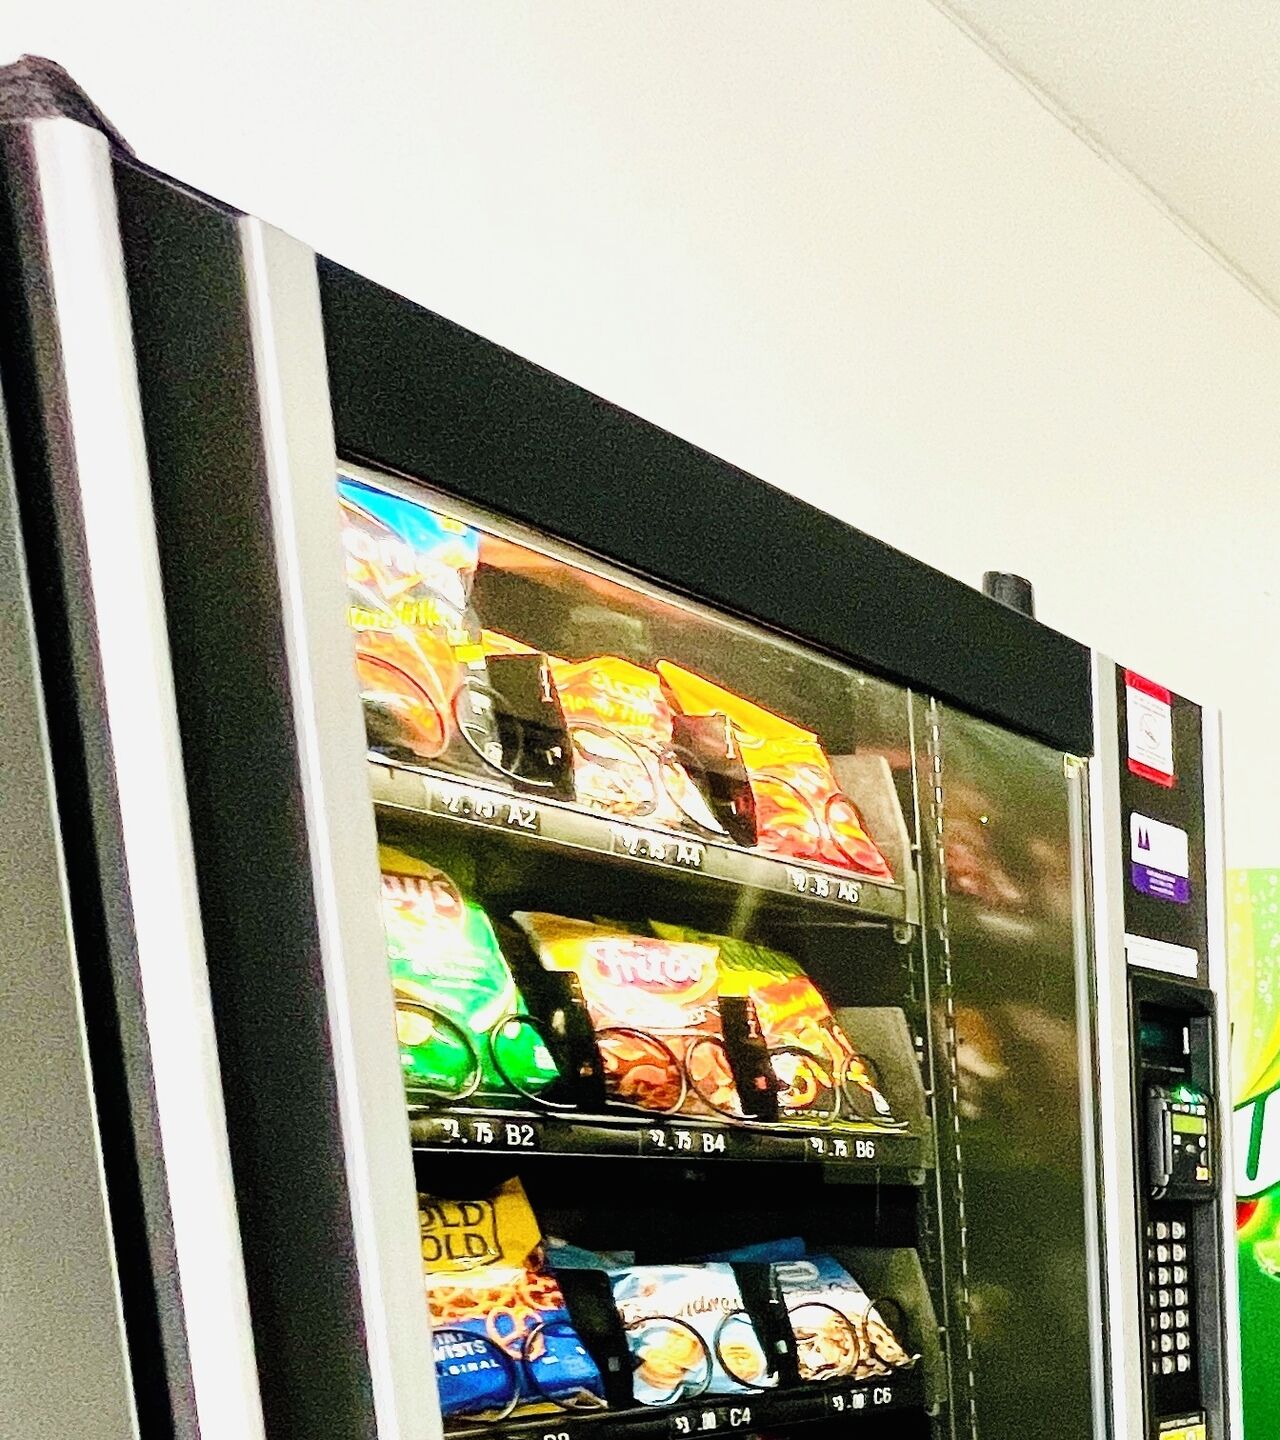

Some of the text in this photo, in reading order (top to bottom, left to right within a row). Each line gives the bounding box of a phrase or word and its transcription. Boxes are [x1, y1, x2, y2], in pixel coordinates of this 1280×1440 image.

[505, 804, 538, 830] A2
[676, 841, 702, 867] A4
[837, 882, 862, 904] A6
[505, 1123, 535, 1147] B2
[702, 1132, 726, 1154] B4
[855, 1139, 876, 1159] B6
[419, 1201, 486, 1229] OLD
[420, 1232, 489, 1263] OLD
[432, 1340, 488, 1362] WISTS
[873, 1387, 892, 1405] C6
[730, 1408, 752, 1428] C4
